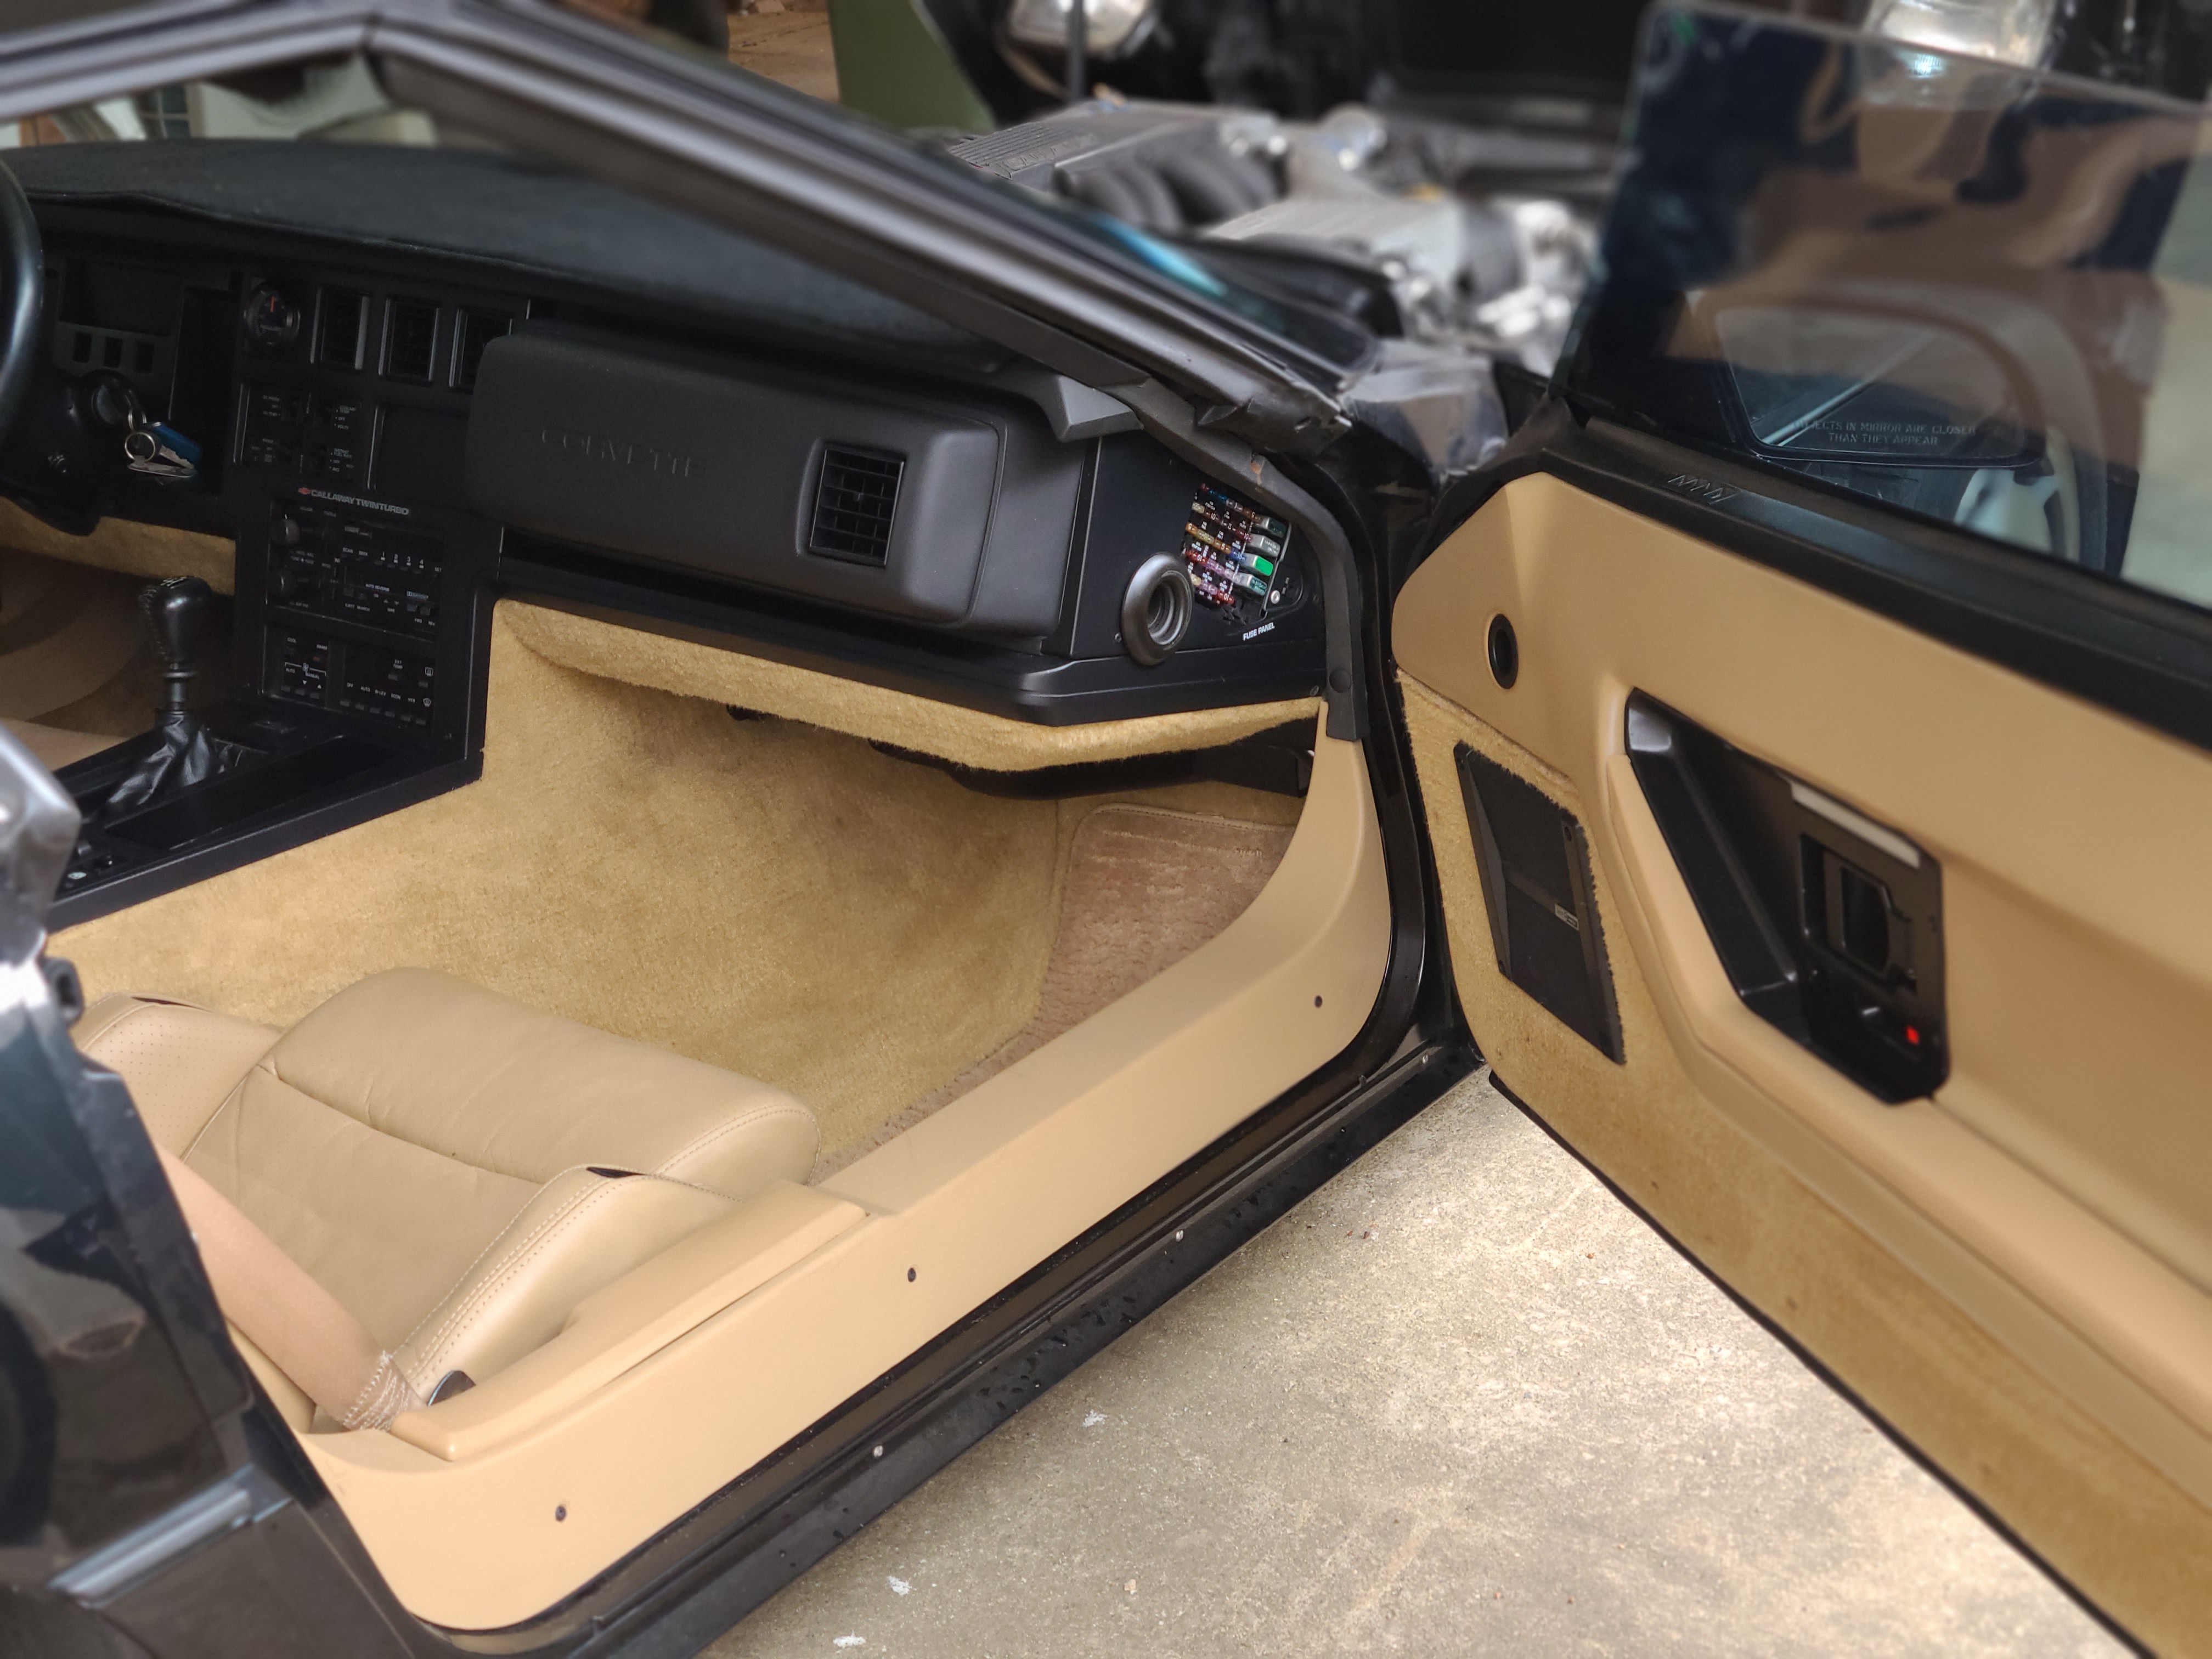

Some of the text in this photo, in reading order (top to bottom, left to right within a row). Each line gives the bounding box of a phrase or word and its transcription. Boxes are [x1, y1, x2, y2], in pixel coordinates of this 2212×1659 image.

[1793, 419, 1976, 435] JECTS IN MIRROR ARE CLOSER
[1829, 432, 1938, 445] THAN THEY APPEAR
[311, 489, 410, 515] CALLAWAY TWINTURBO
[1243, 622, 1275, 641] FUSE PANEL
